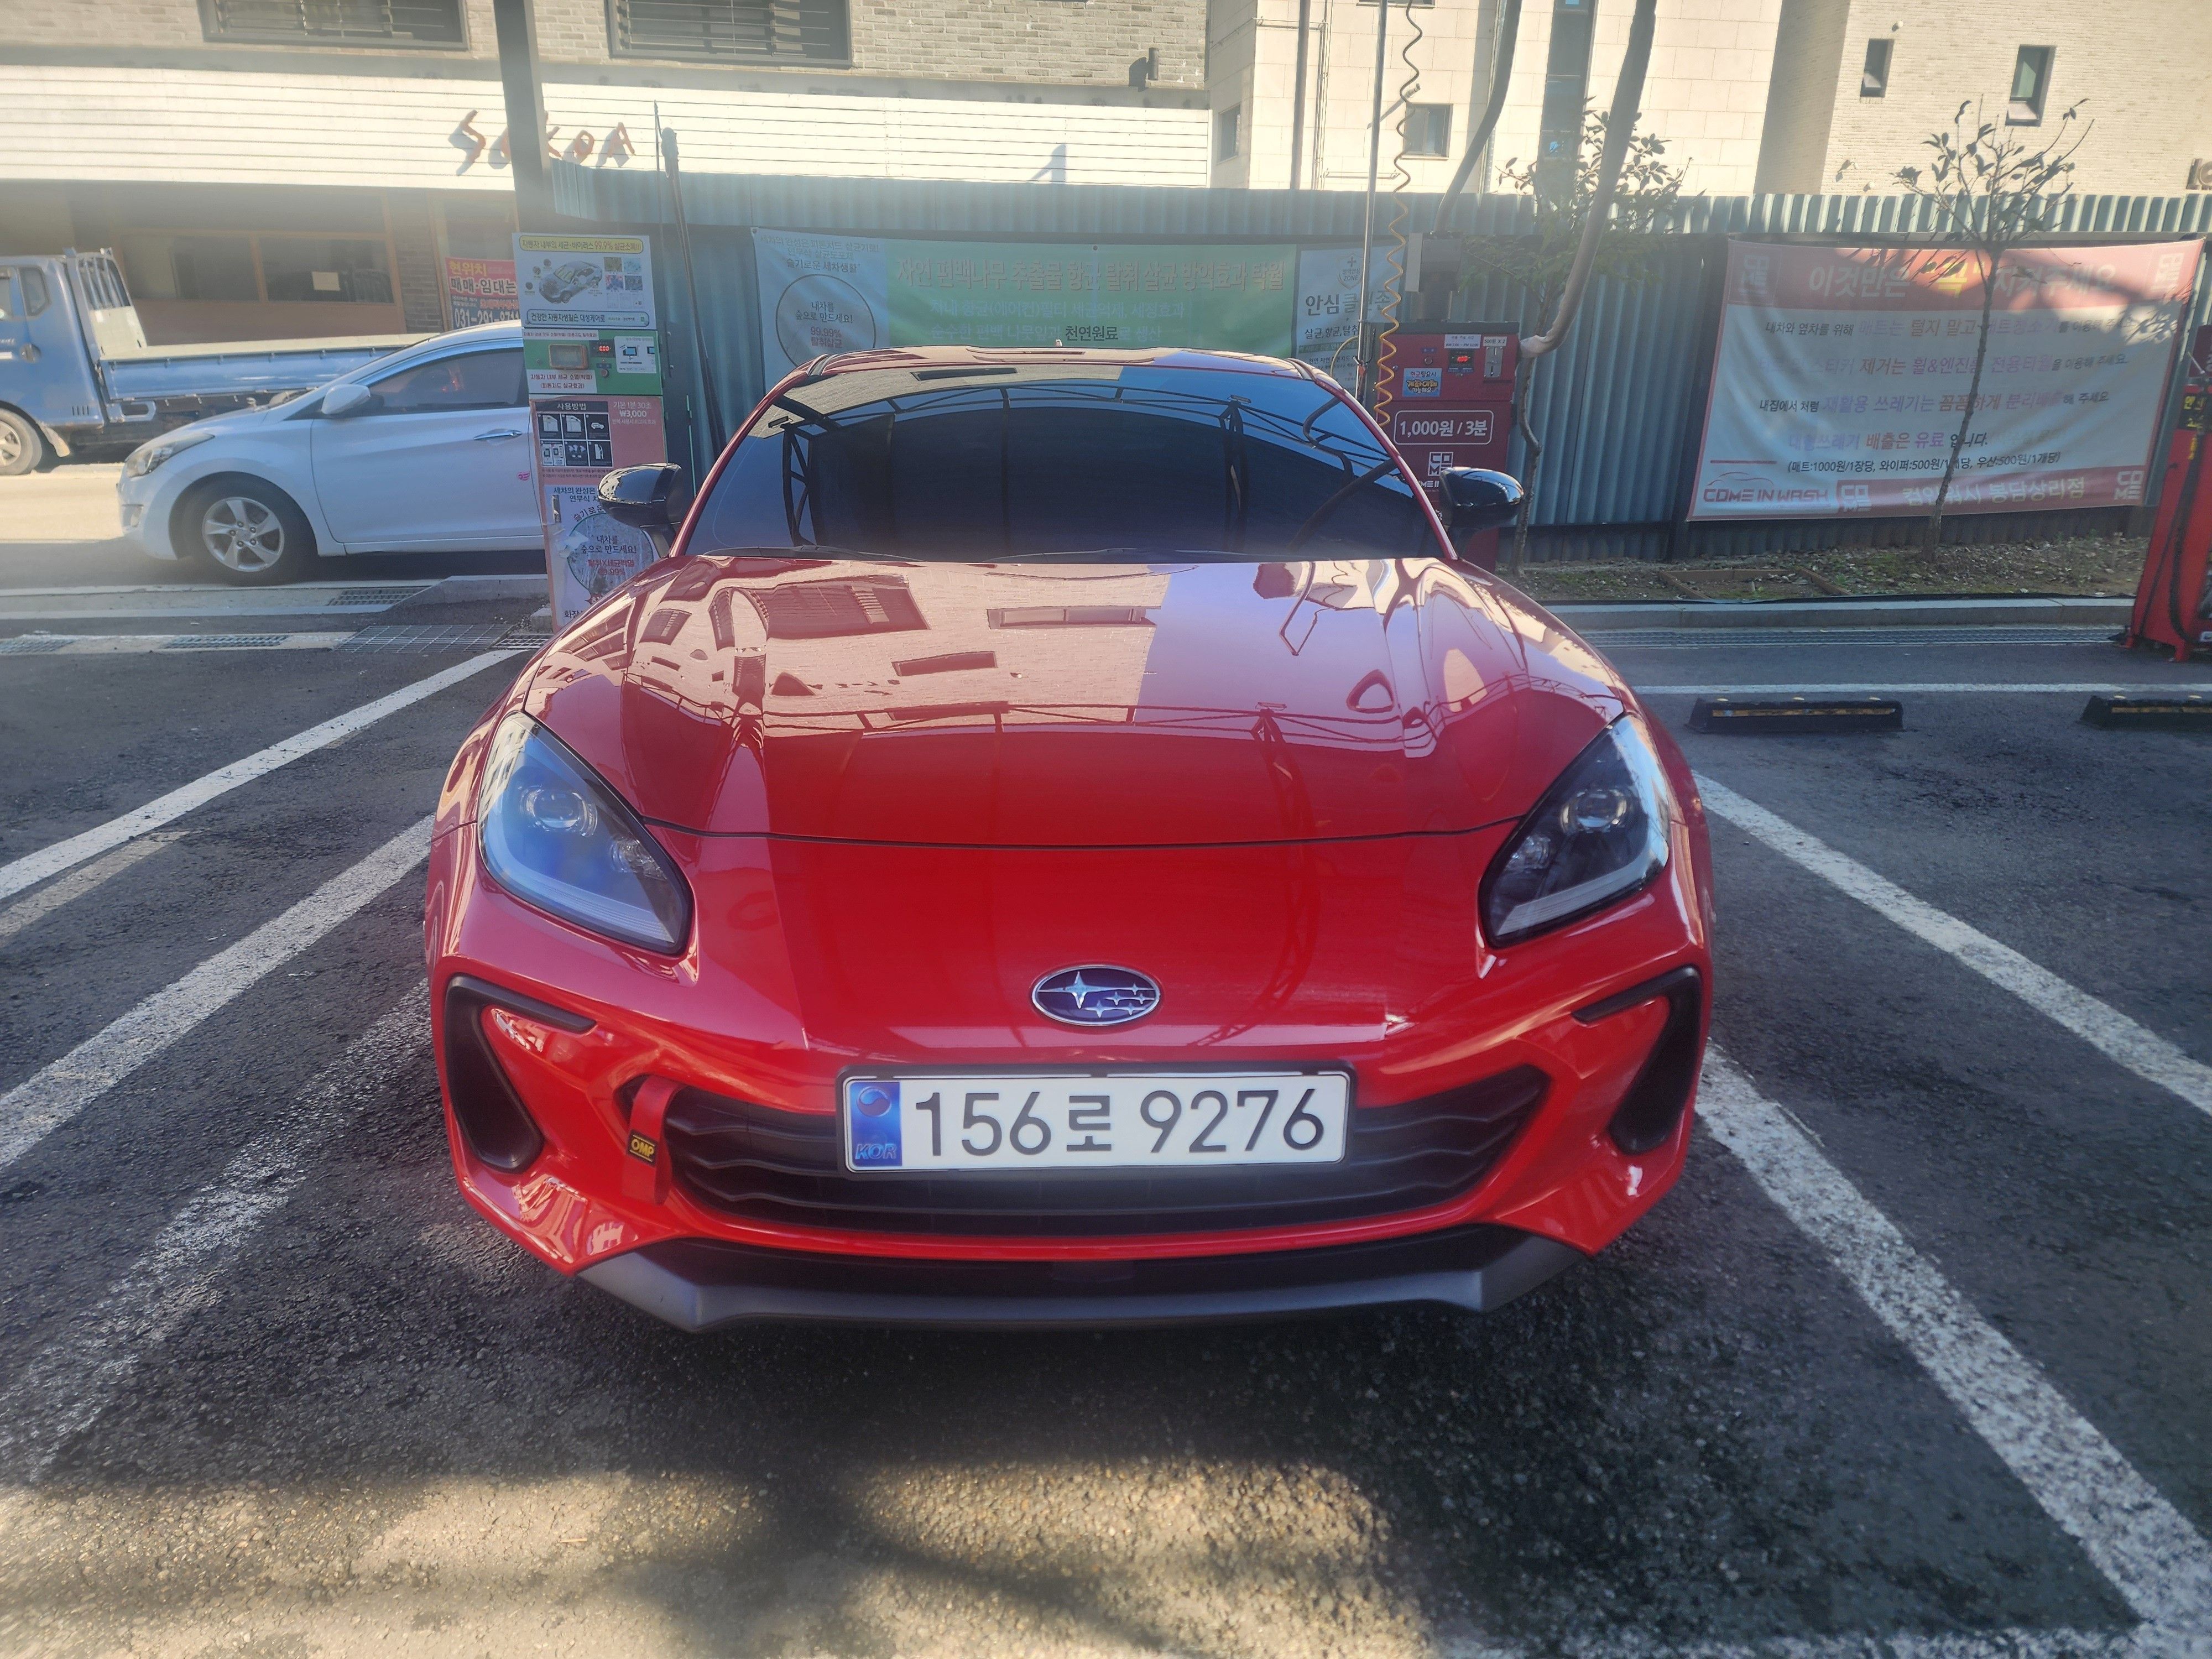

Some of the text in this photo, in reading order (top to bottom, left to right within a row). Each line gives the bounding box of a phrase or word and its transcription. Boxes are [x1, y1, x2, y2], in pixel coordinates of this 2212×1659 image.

[785, 238, 809, 248] 완성은
[811, 239, 841, 251] 피톤치드
[450, 260, 487, 277] 현위치
[937, 259, 1007, 290] 편백나무
[1013, 260, 1062, 290] 추출물
[1067, 261, 1101, 291] 항균
[1106, 260, 1139, 291] 탈취
[1145, 261, 1178, 291] 살균
[1182, 261, 1248, 291] 방역효과
[1253, 261, 1284, 291] 탁월
[1809, 265, 1911, 298] 이것만은
[1994, 263, 2117, 298] 지켜주세요
[811, 301, 834, 312] 내차를
[1132, 301, 1185, 319] 세정효과
[796, 310, 853, 324] 숲으로 만드세요!
[811, 326, 842, 338] 99.99%
[931, 324, 972, 341] 순수한
[977, 324, 1003, 341] 편백
[1136, 326, 1163, 342] 생산
[1766, 321, 1796, 335] 내차와
[1798, 322, 1829, 336] 옆차를
[1833, 323, 1855, 336] 위해
[1859, 319, 1904, 336] 매트는
[1911, 319, 1940, 337] 털지
[1947, 319, 1976, 336] 말고
[811, 337, 842, 348] 탈취살균
[1859, 357, 1907, 374] 제거는
[2064, 356, 2094, 370] 이용해
[557, 402, 586, 411] 사용방법
[1760, 398, 1798, 412] 내집에서
[1801, 400, 1819, 413] 처럼
[1823, 394, 1869, 413] 재활용
[1873, 394, 1935, 413] 쓰레기는
[1939, 392, 2002, 412] 꼼꼼하게
[2078, 391, 2110, 404] 주세요
[619, 410, 647, 419] ₩3,000
[1400, 420, 1488, 438] 1,000원 / 3분
[1788, 433, 1861, 451] 대형쓰레기
[1866, 432, 1911, 450] 배출은
[1915, 432, 1945, 448] 유료
[554, 486, 596, 495] 세차의 완성은
[569, 494, 590, 503] 연무식
[1703, 488, 1829, 503] COME IN WASH
[1989, 477, 2085, 505] 봉담상리점
[596, 535, 619, 545] 내차를
[581, 545, 636, 554] 숲으로 만드세요!
[915, 1088, 1325, 1157] 156로 9276
[630, 1139, 654, 1157] OMP
[854, 1142, 898, 1161] KOR
